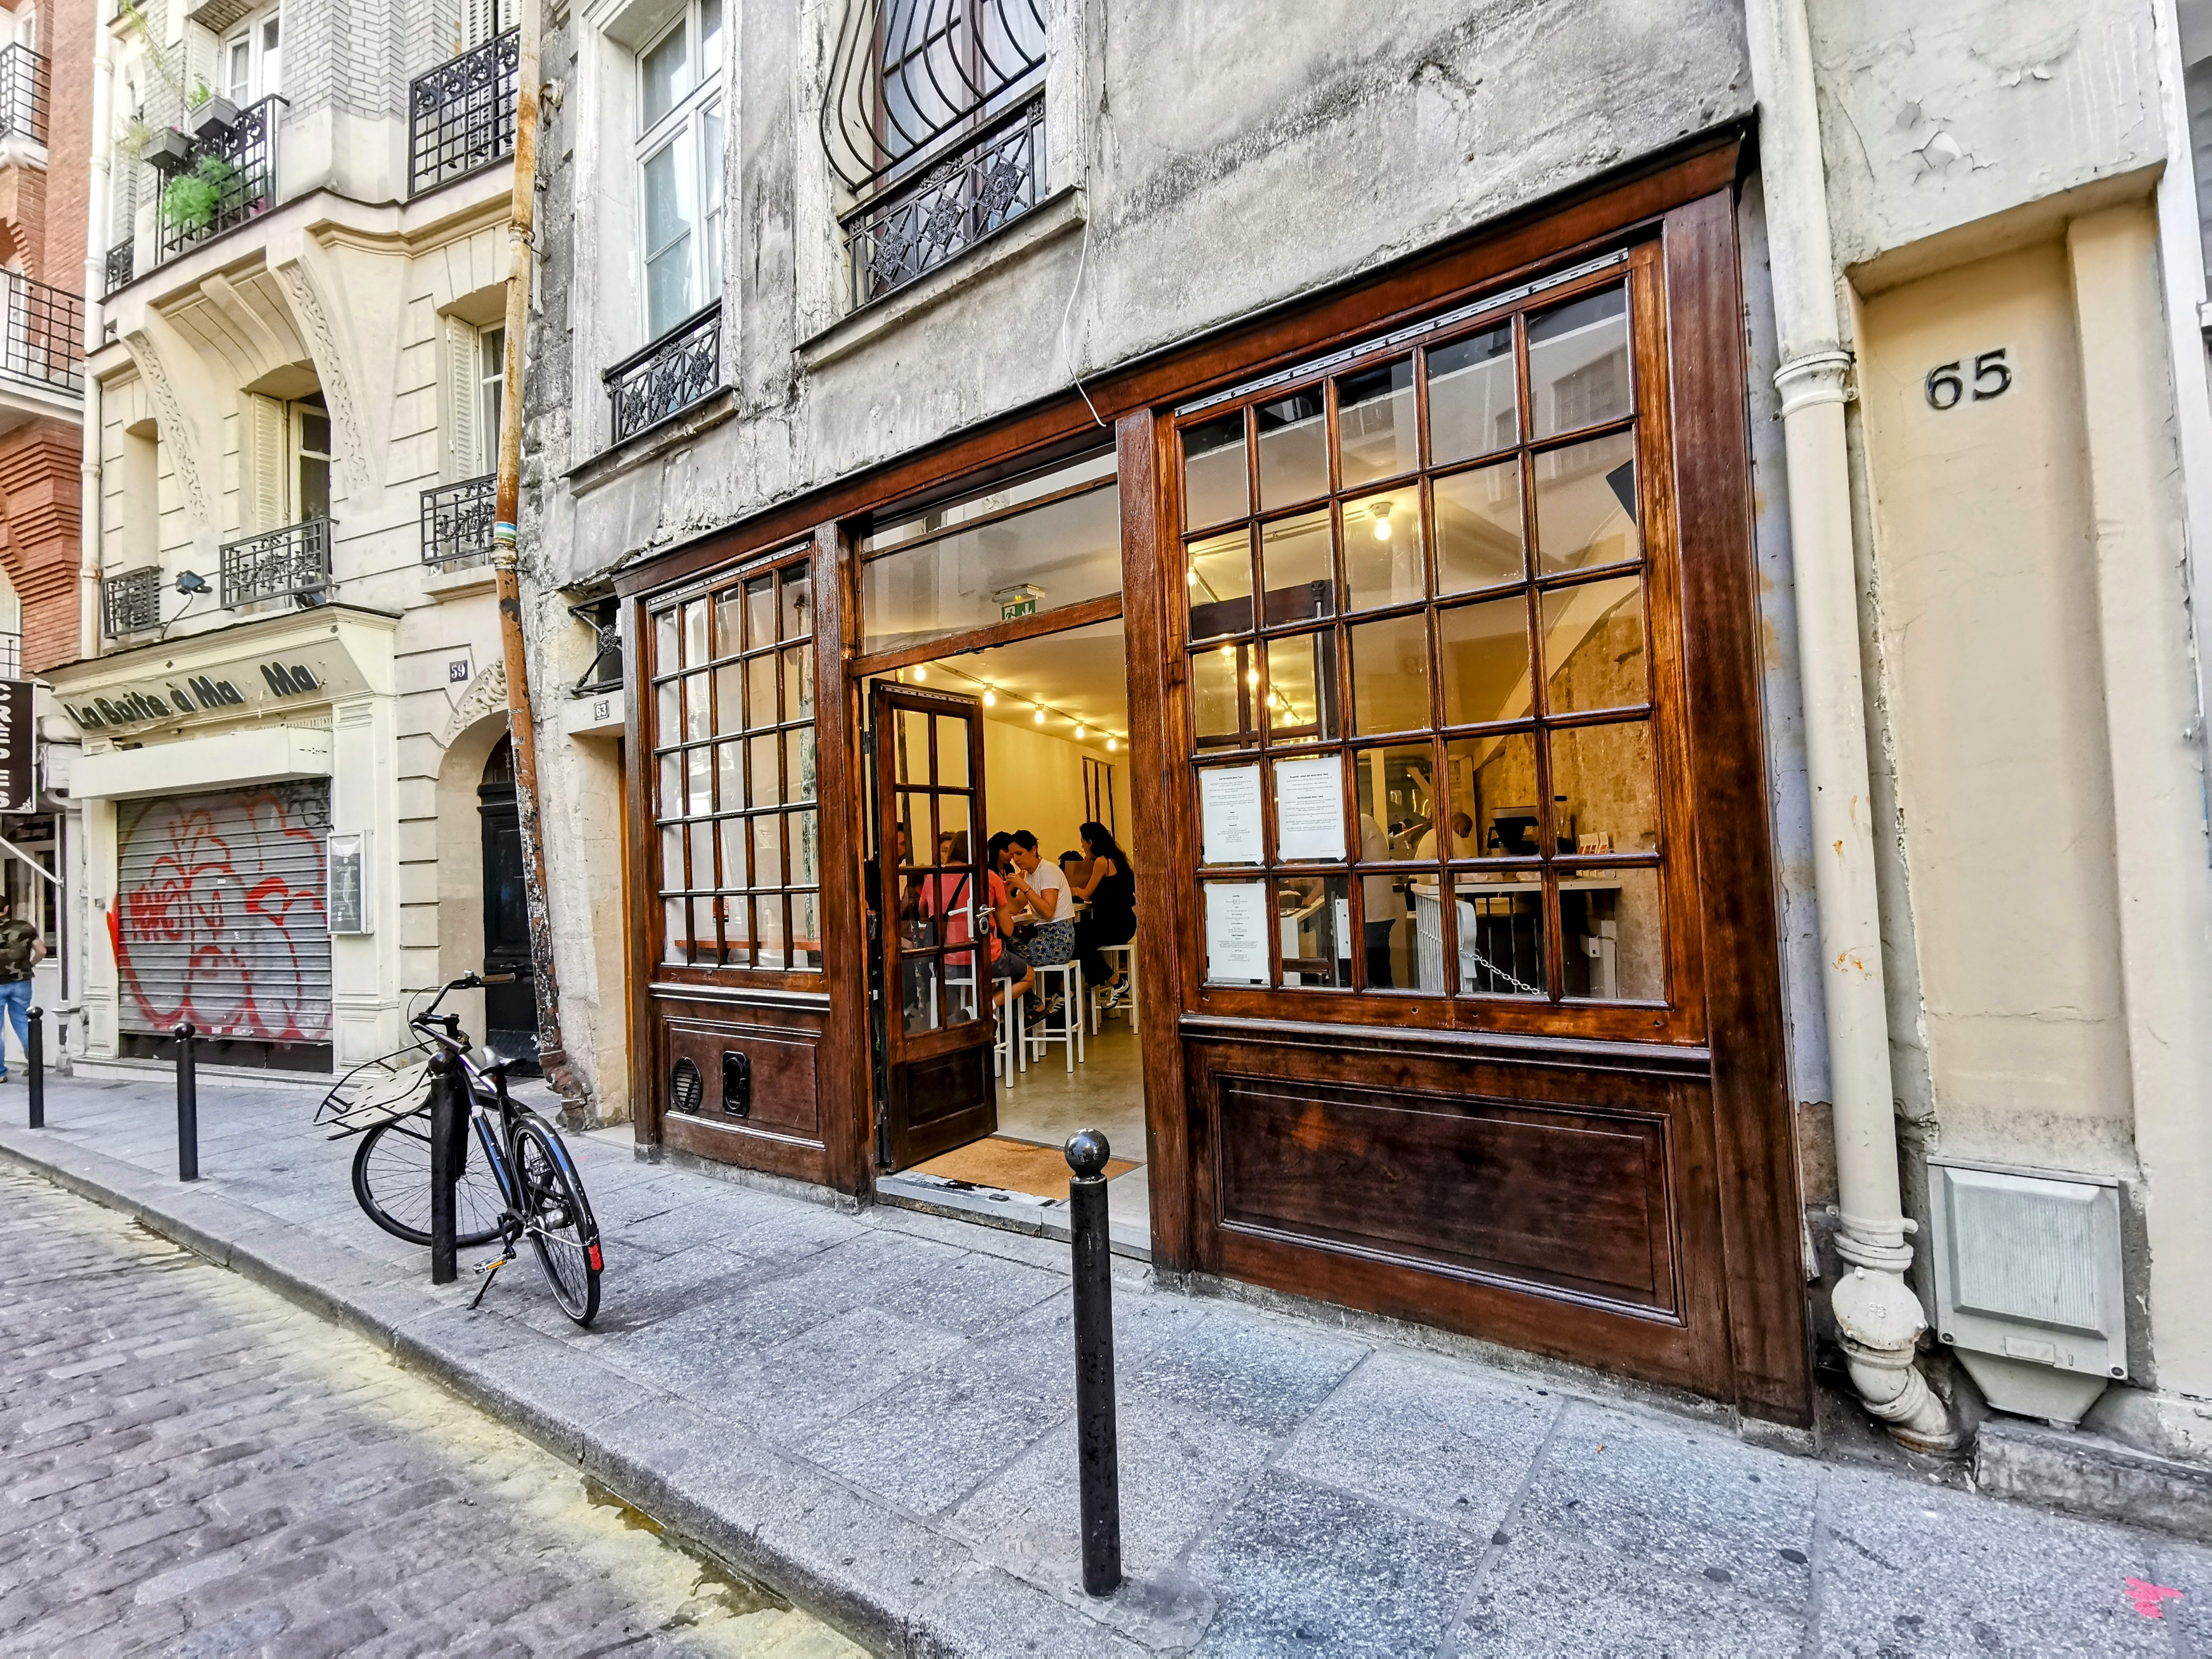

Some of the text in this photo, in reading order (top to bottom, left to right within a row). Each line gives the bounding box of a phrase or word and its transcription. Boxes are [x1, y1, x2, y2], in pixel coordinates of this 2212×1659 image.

[1924, 347, 2012, 410] 65
[451, 664, 465, 679] 59
[64, 703, 106, 730] La
[166, 682, 196, 713] à
[188, 675, 245, 709] Ma
[260, 662, 319, 697] Ma
[596, 704, 607, 717] 63
